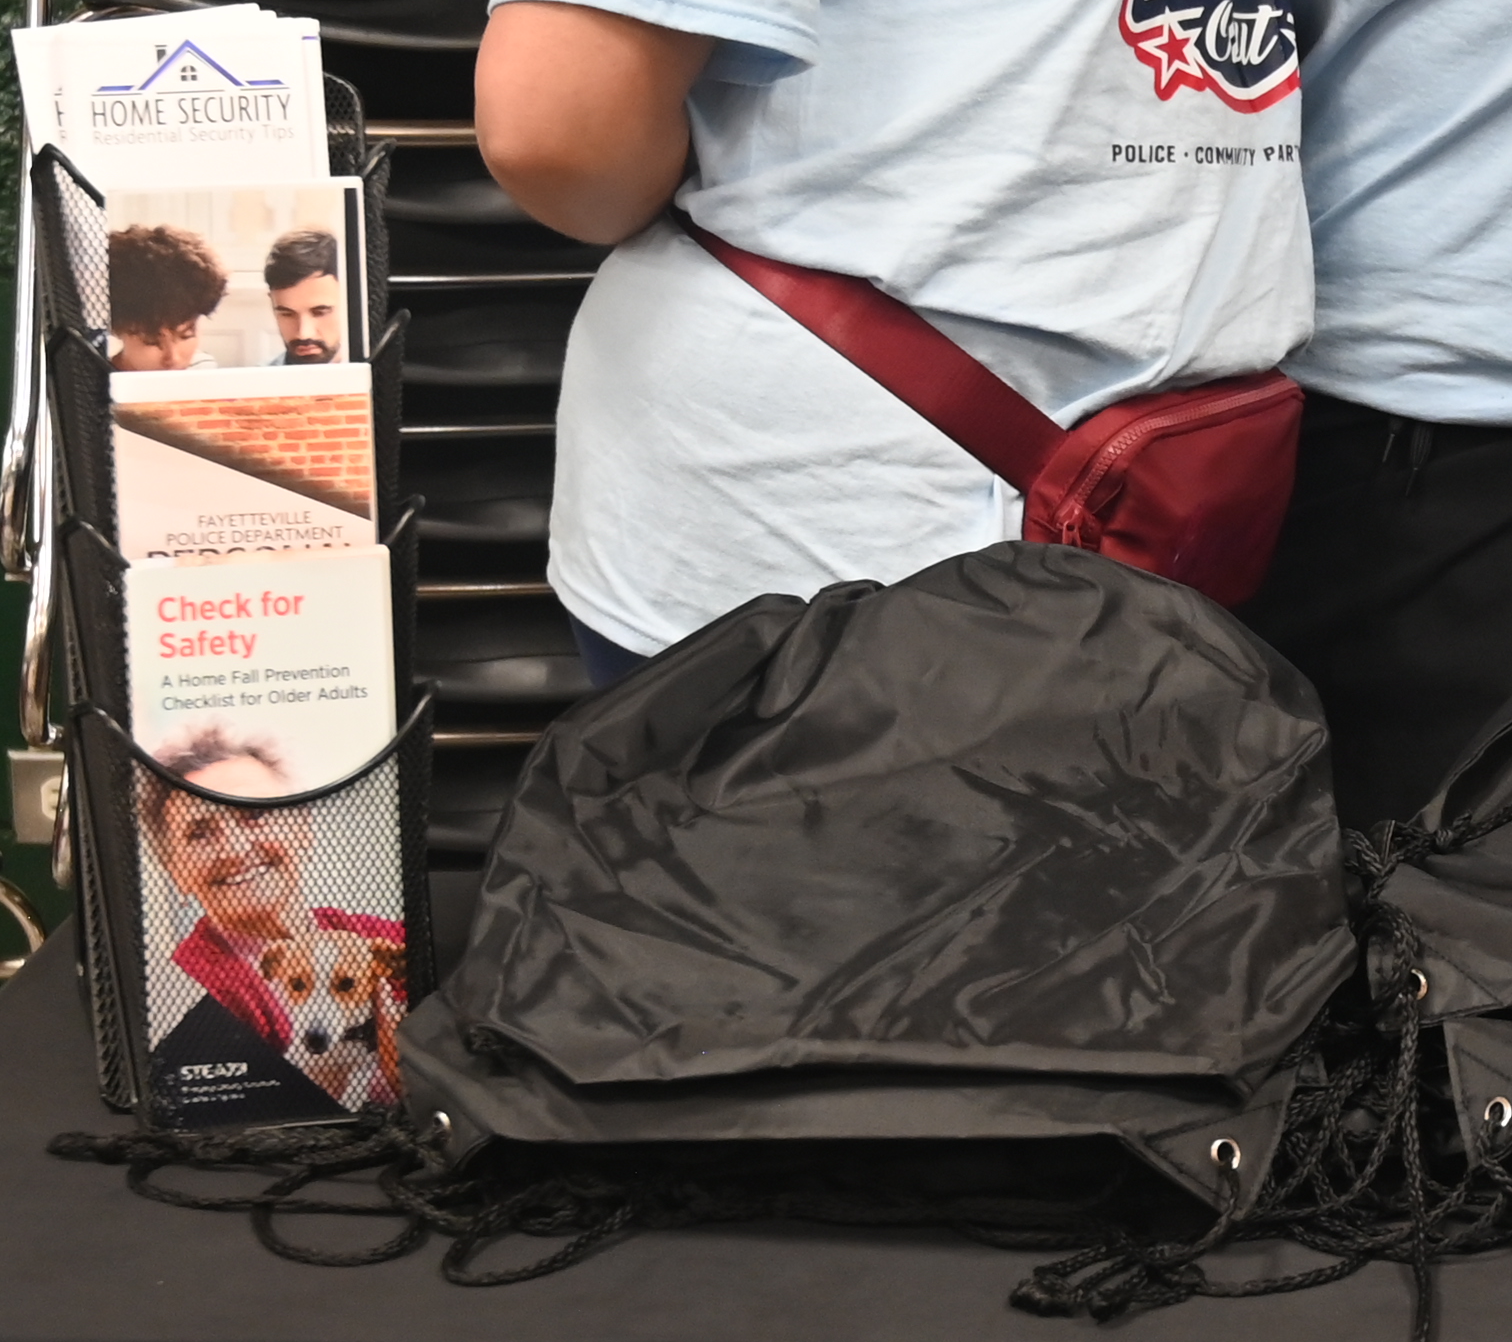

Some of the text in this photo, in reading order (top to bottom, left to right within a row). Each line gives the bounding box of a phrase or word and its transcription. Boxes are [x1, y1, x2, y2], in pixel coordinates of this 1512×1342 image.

[91, 99, 167, 127] HOME
[178, 93, 291, 125] SECURITY
[93, 124, 295, 145] Residential Security Tips
[1112, 144, 1176, 163] POLICE
[198, 511, 312, 528] FAYETTEVILLE
[166, 526, 344, 546] POLICE DEPARTMENT
[157, 590, 305, 623] Check for
[159, 630, 258, 659] Safety
[161, 664, 351, 689] A Home Fall Prevention
[161, 685, 368, 711] Checklist for Older Adults
